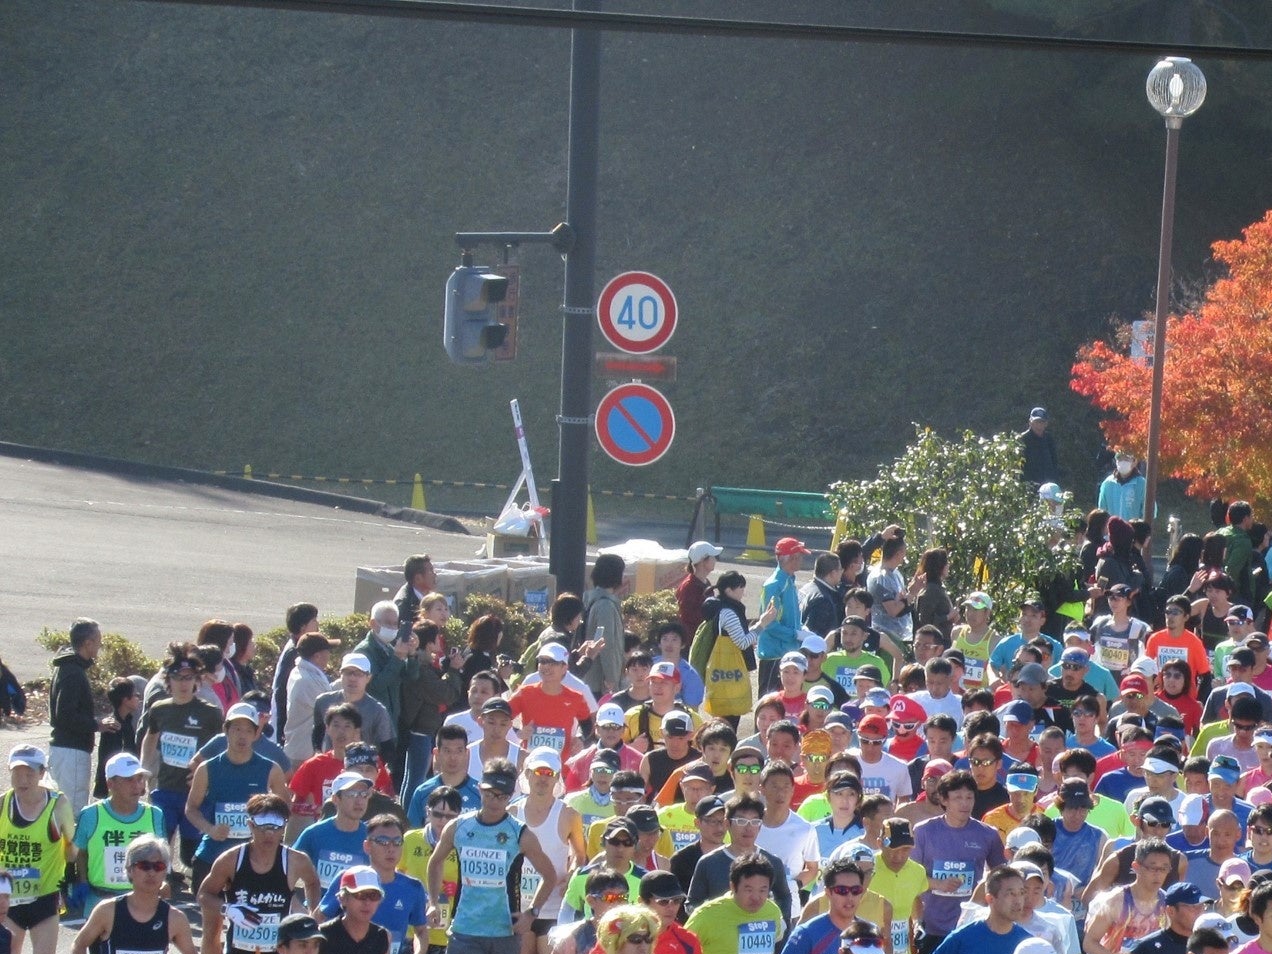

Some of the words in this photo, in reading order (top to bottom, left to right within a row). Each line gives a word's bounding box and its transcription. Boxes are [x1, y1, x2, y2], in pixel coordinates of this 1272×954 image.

[617, 295, 658, 330] 40
[711, 668, 744, 686] Step
[537, 727, 557, 735] Step
[225, 803, 247, 814] Step
[7, 833, 31, 841] KAZU
[675, 832, 696, 842] Step
[329, 852, 352, 863] Step
[466, 850, 506, 860] GUNZE
[463, 860, 496, 876] 10539
[943, 861, 967, 871] Step
[748, 922, 769, 932] Step
[741, 934, 773, 950] 10449
